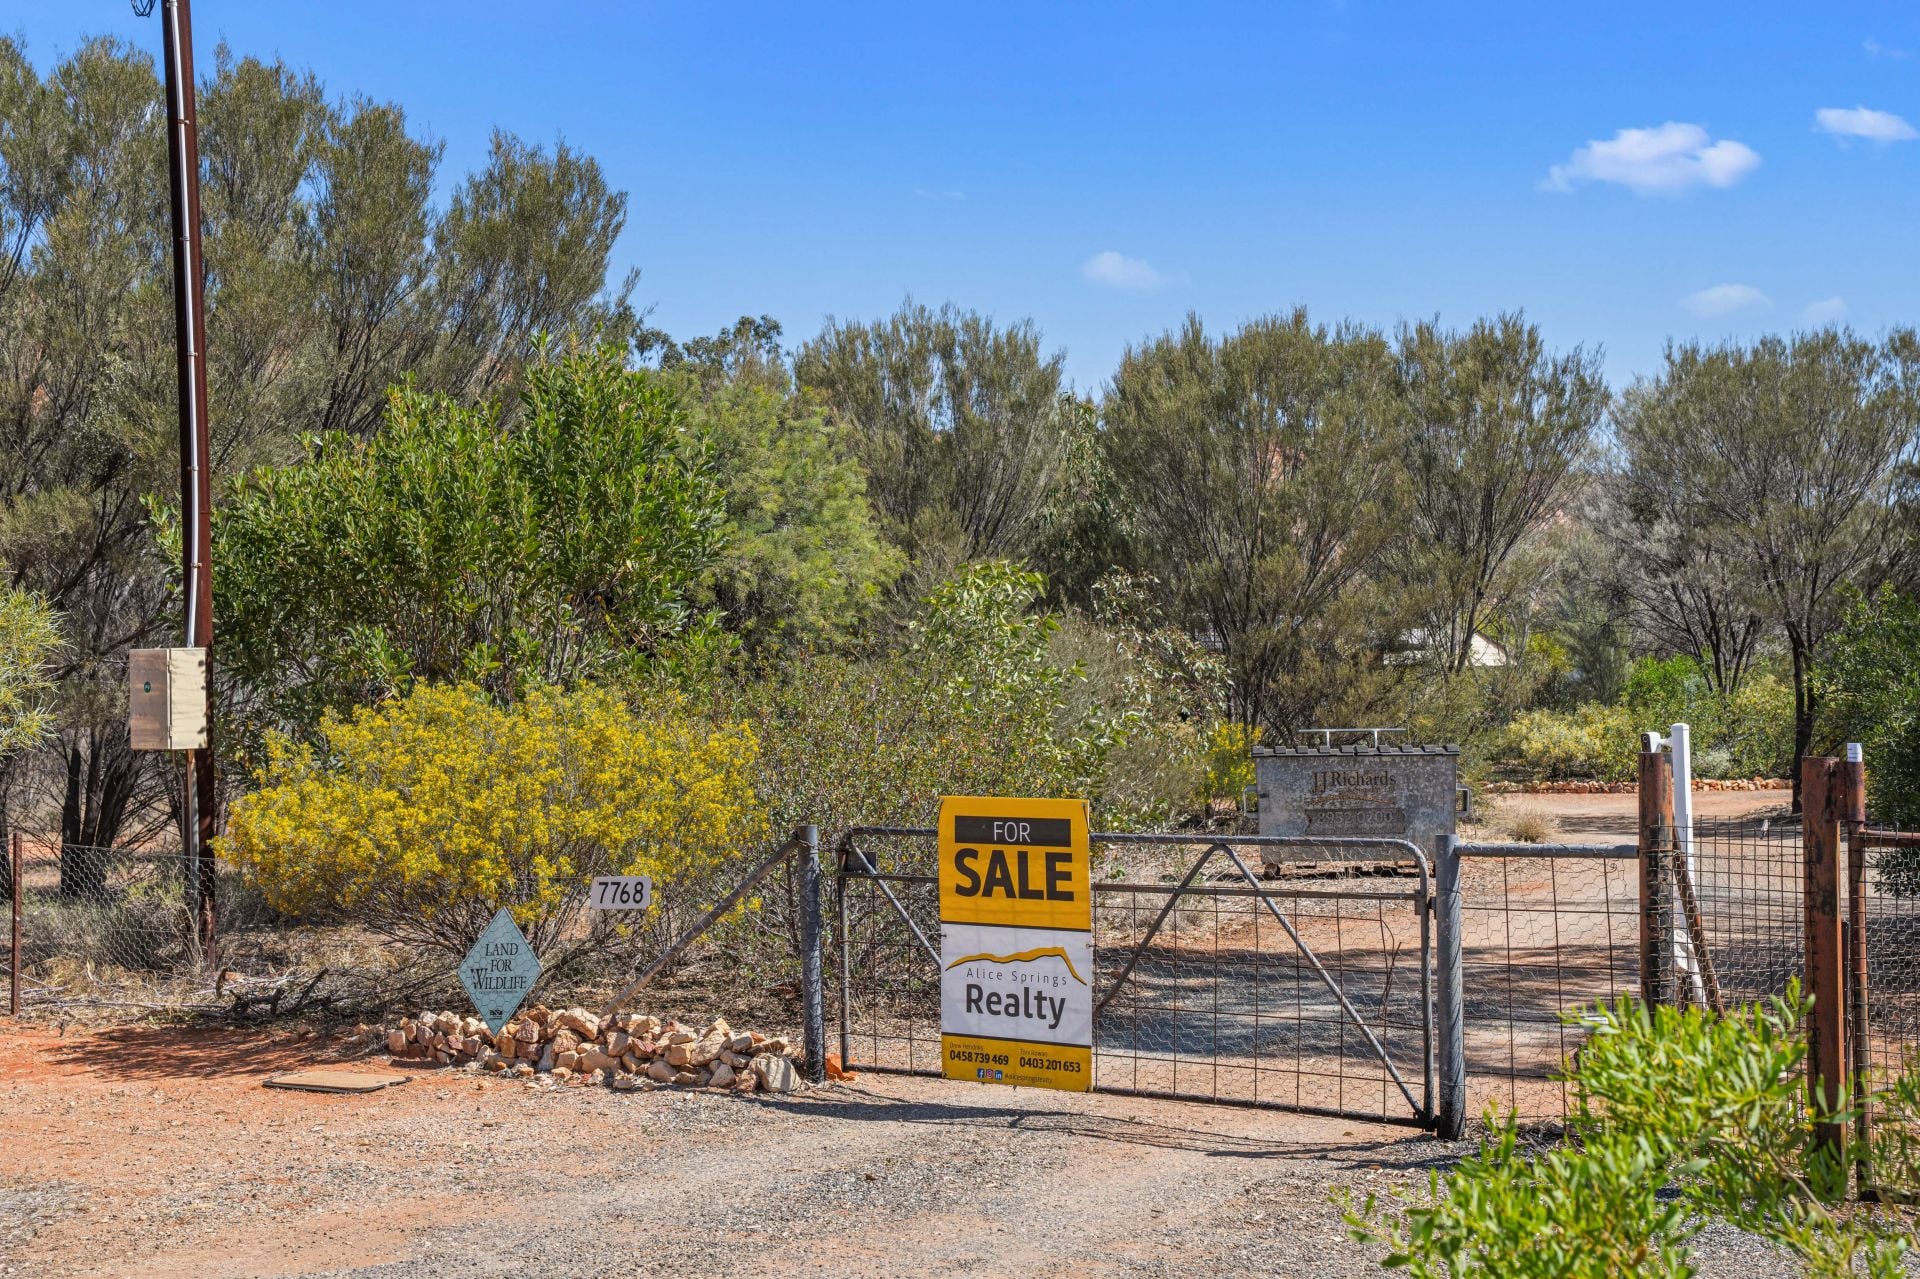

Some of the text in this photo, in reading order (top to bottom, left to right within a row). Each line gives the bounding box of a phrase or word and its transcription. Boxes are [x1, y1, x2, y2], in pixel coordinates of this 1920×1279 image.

[1331, 770, 1397, 786] Richards
[993, 821, 1031, 842] FOR
[954, 848, 1075, 901] SALE
[598, 881, 644, 904] 7768
[485, 942, 519, 957] LAND
[490, 959, 513, 973] FOR
[966, 967, 1067, 987] Alice Springs
[965, 983, 1067, 1030] Realty
[950, 1049, 1009, 1066] 0458 739 469
[1019, 1056, 1081, 1073] 0403 201 653
